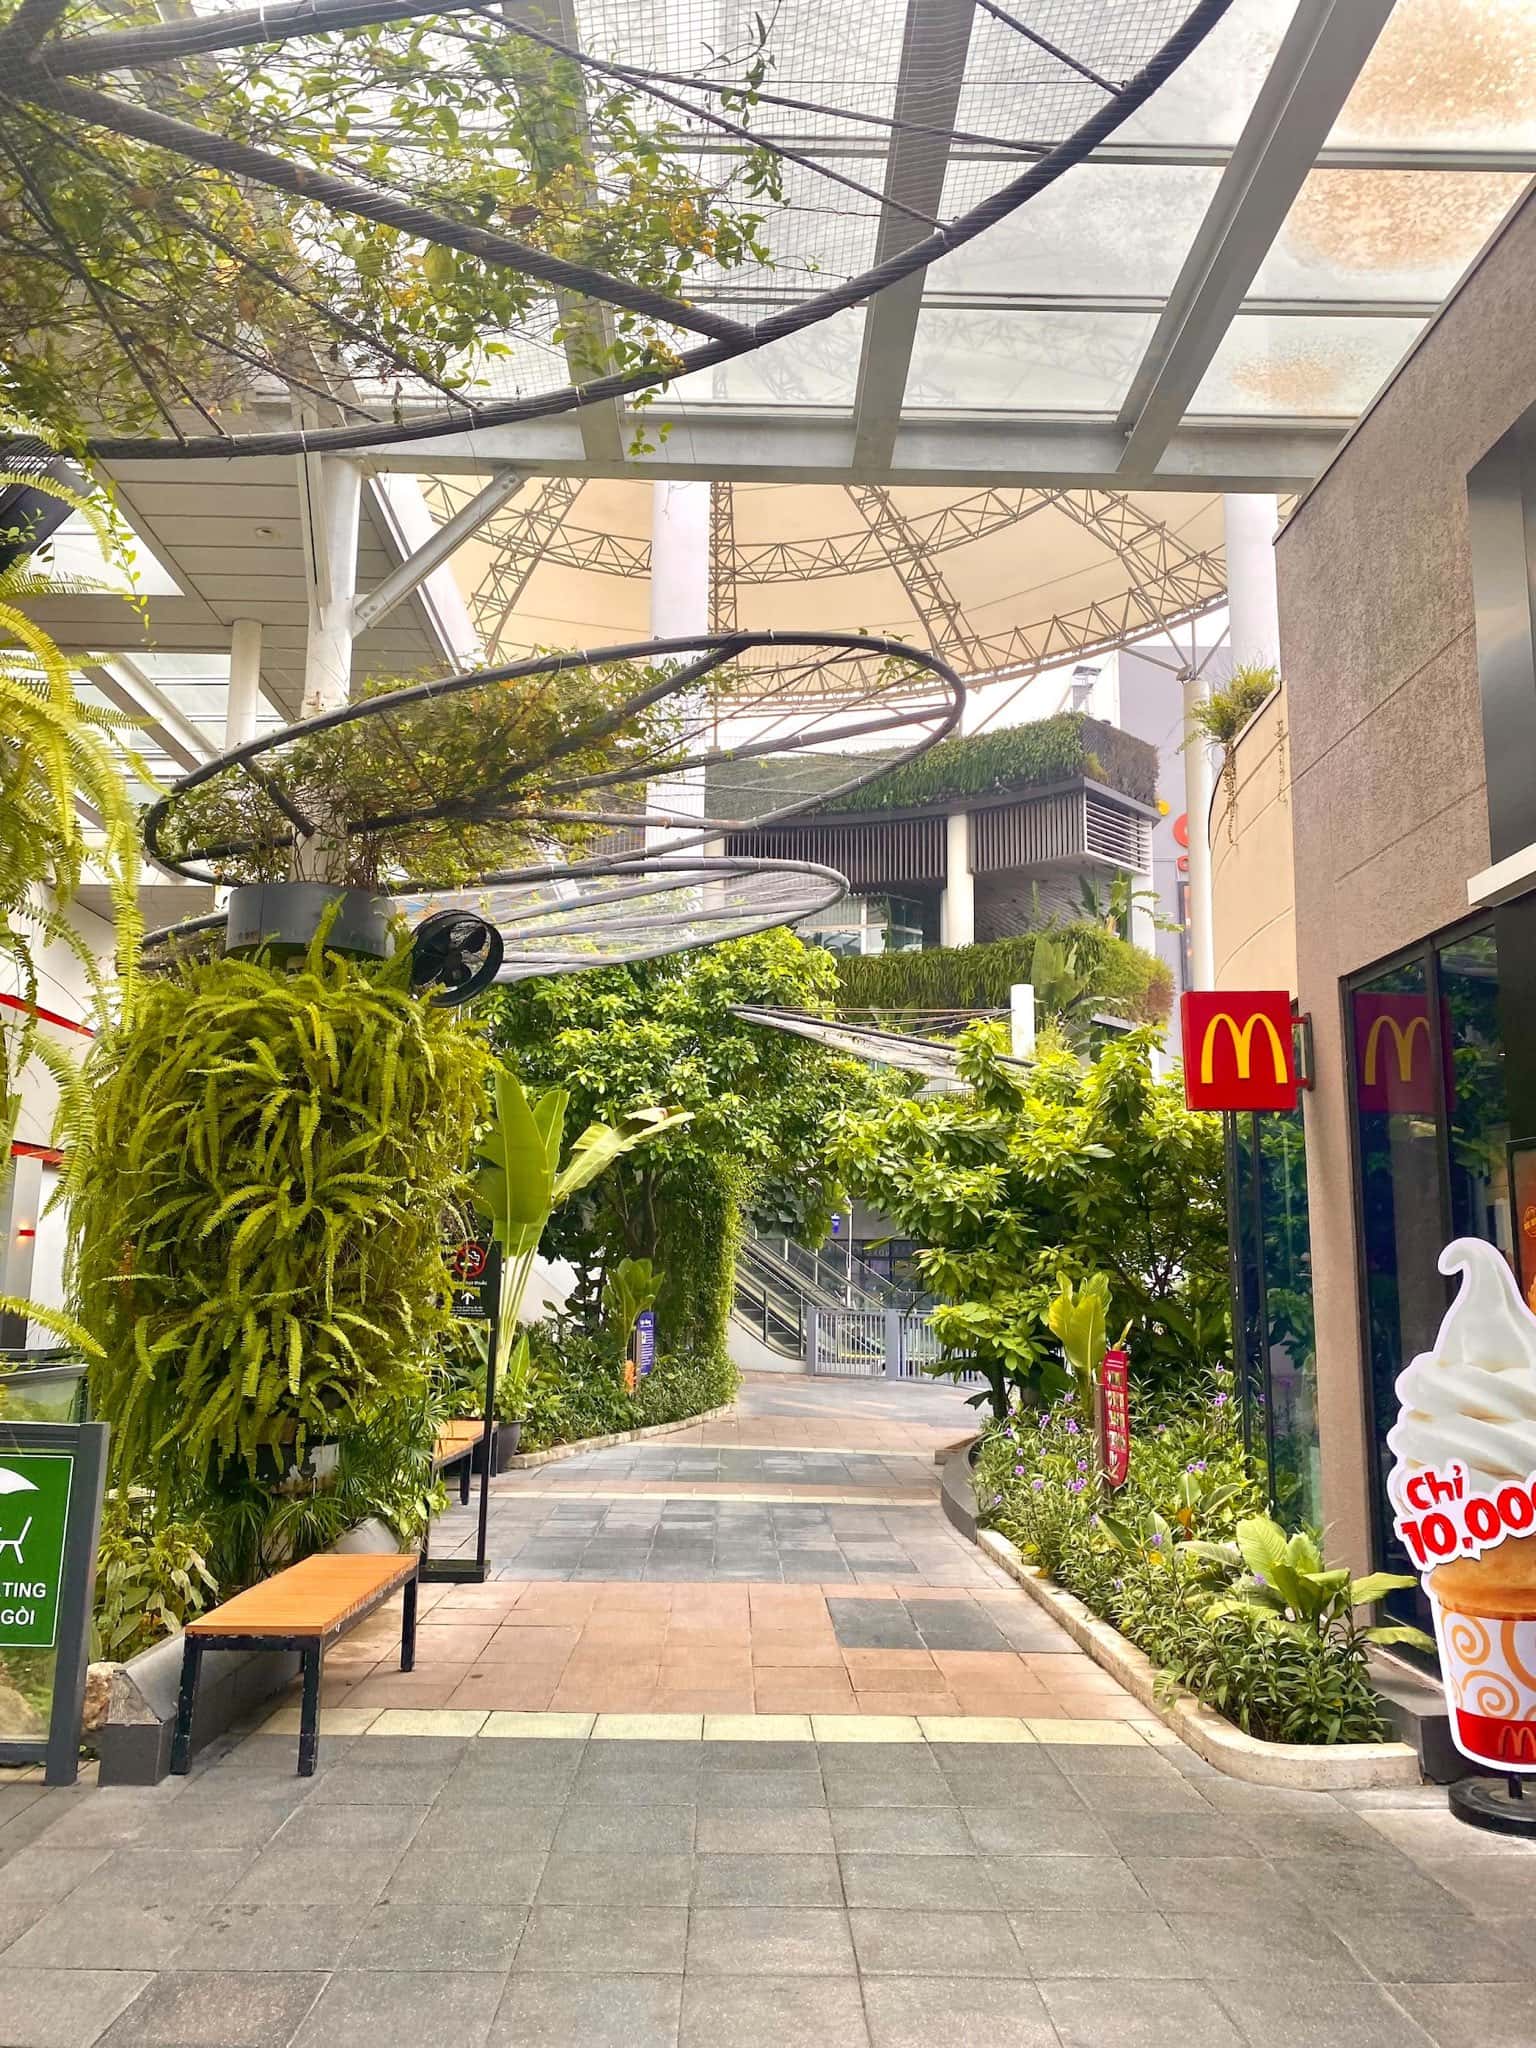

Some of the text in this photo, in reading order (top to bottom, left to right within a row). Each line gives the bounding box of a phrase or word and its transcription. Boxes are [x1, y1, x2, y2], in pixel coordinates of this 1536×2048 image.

[1406, 1465, 1463, 1510] Chỉ
[1400, 1482, 1536, 1564] 10.00
[0, 1582, 46, 1598] TING
